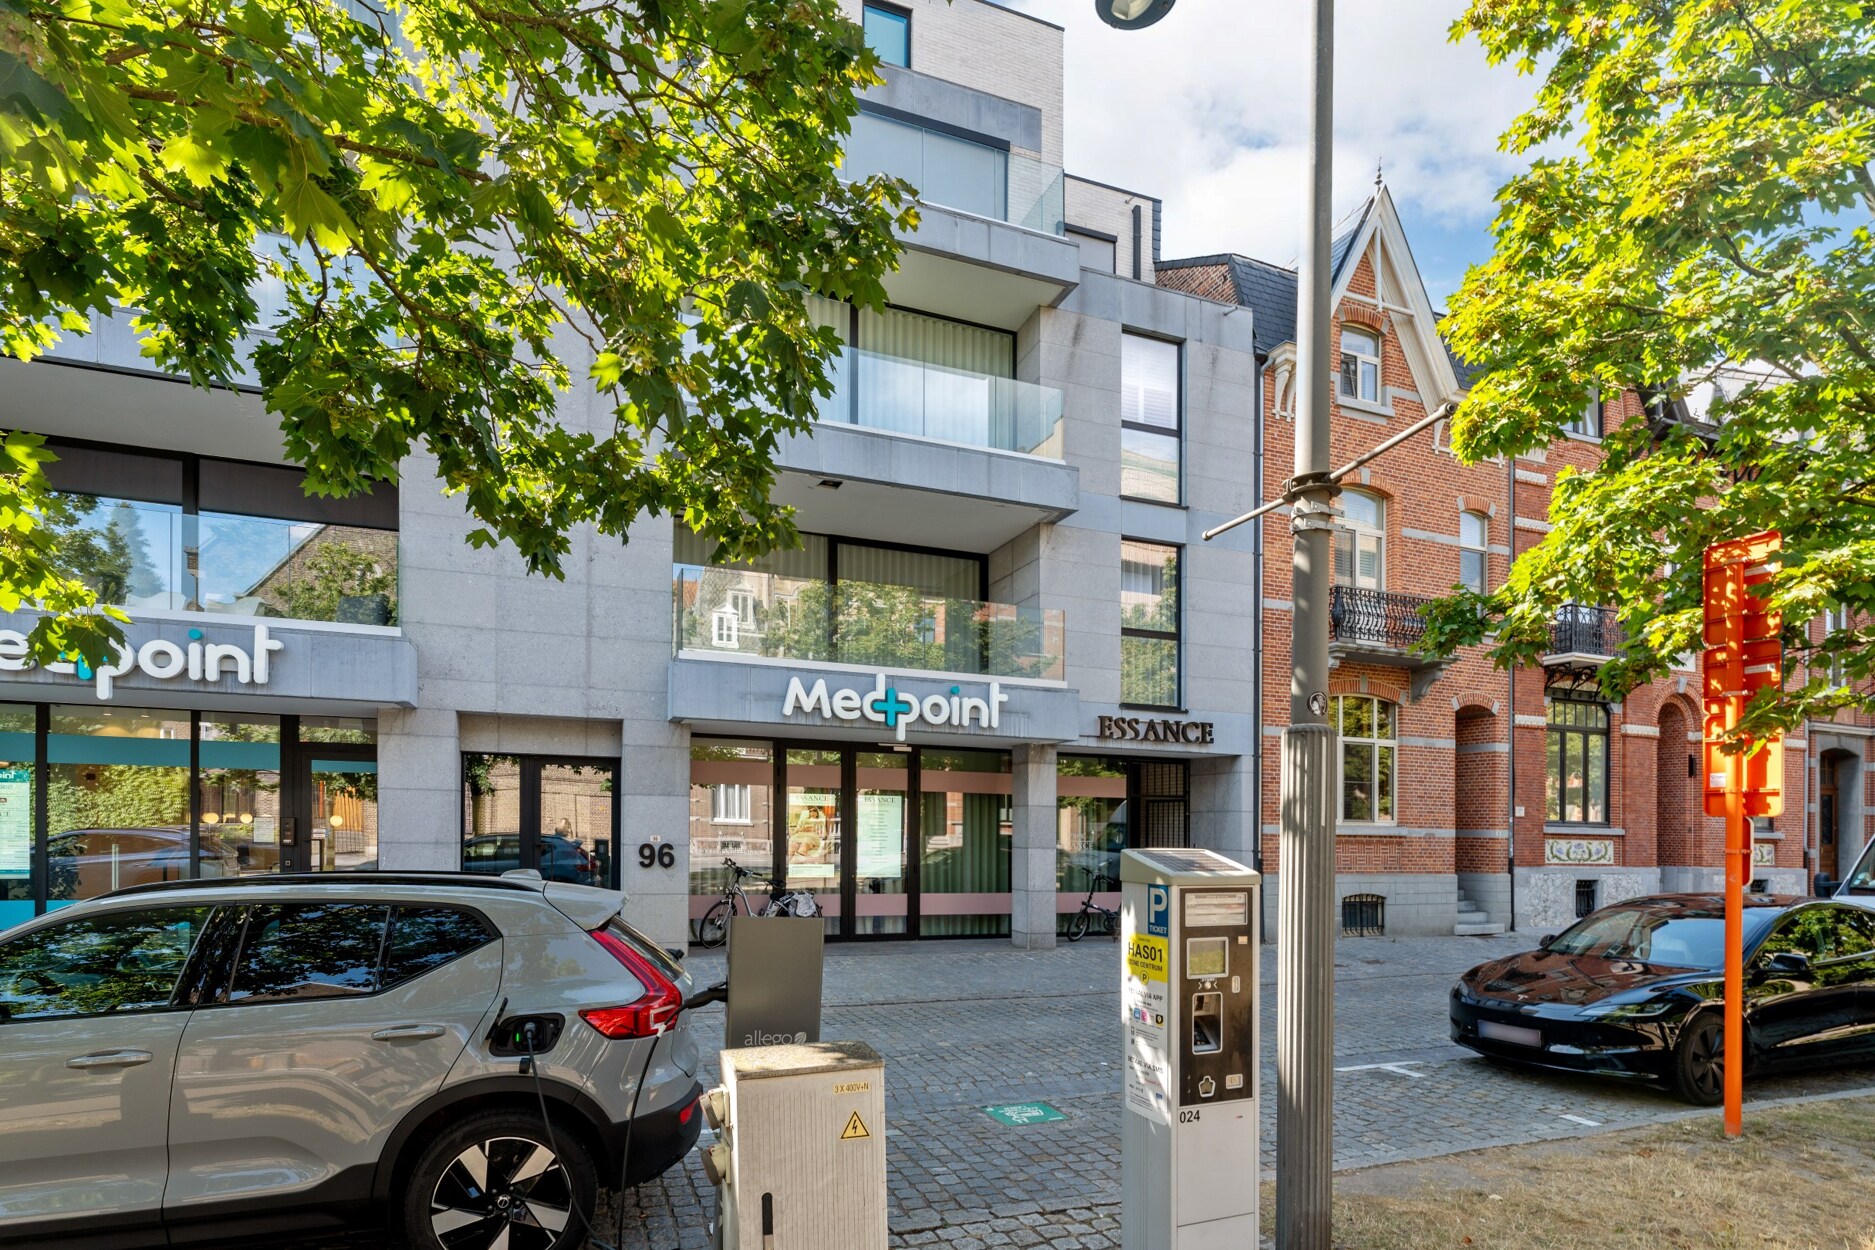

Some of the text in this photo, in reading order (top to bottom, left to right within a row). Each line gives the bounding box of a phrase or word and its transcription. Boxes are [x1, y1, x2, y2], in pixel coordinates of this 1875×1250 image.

[0, 624, 285, 700] epoint
[782, 673, 1009, 741] Medpoint
[1097, 715, 1215, 744] ESSANCE
[639, 843, 675, 868] 96
[1149, 887, 1168, 924] P
[1149, 925, 1168, 934] TICKET
[1128, 942, 1163, 963] HAS01
[1140, 961, 1163, 972] CENTRUM
[744, 1030, 793, 1046] allego
[834, 1085, 839, 1093] 3
[845, 1082, 869, 1092] 400V+N
[1179, 1110, 1201, 1124] 024
